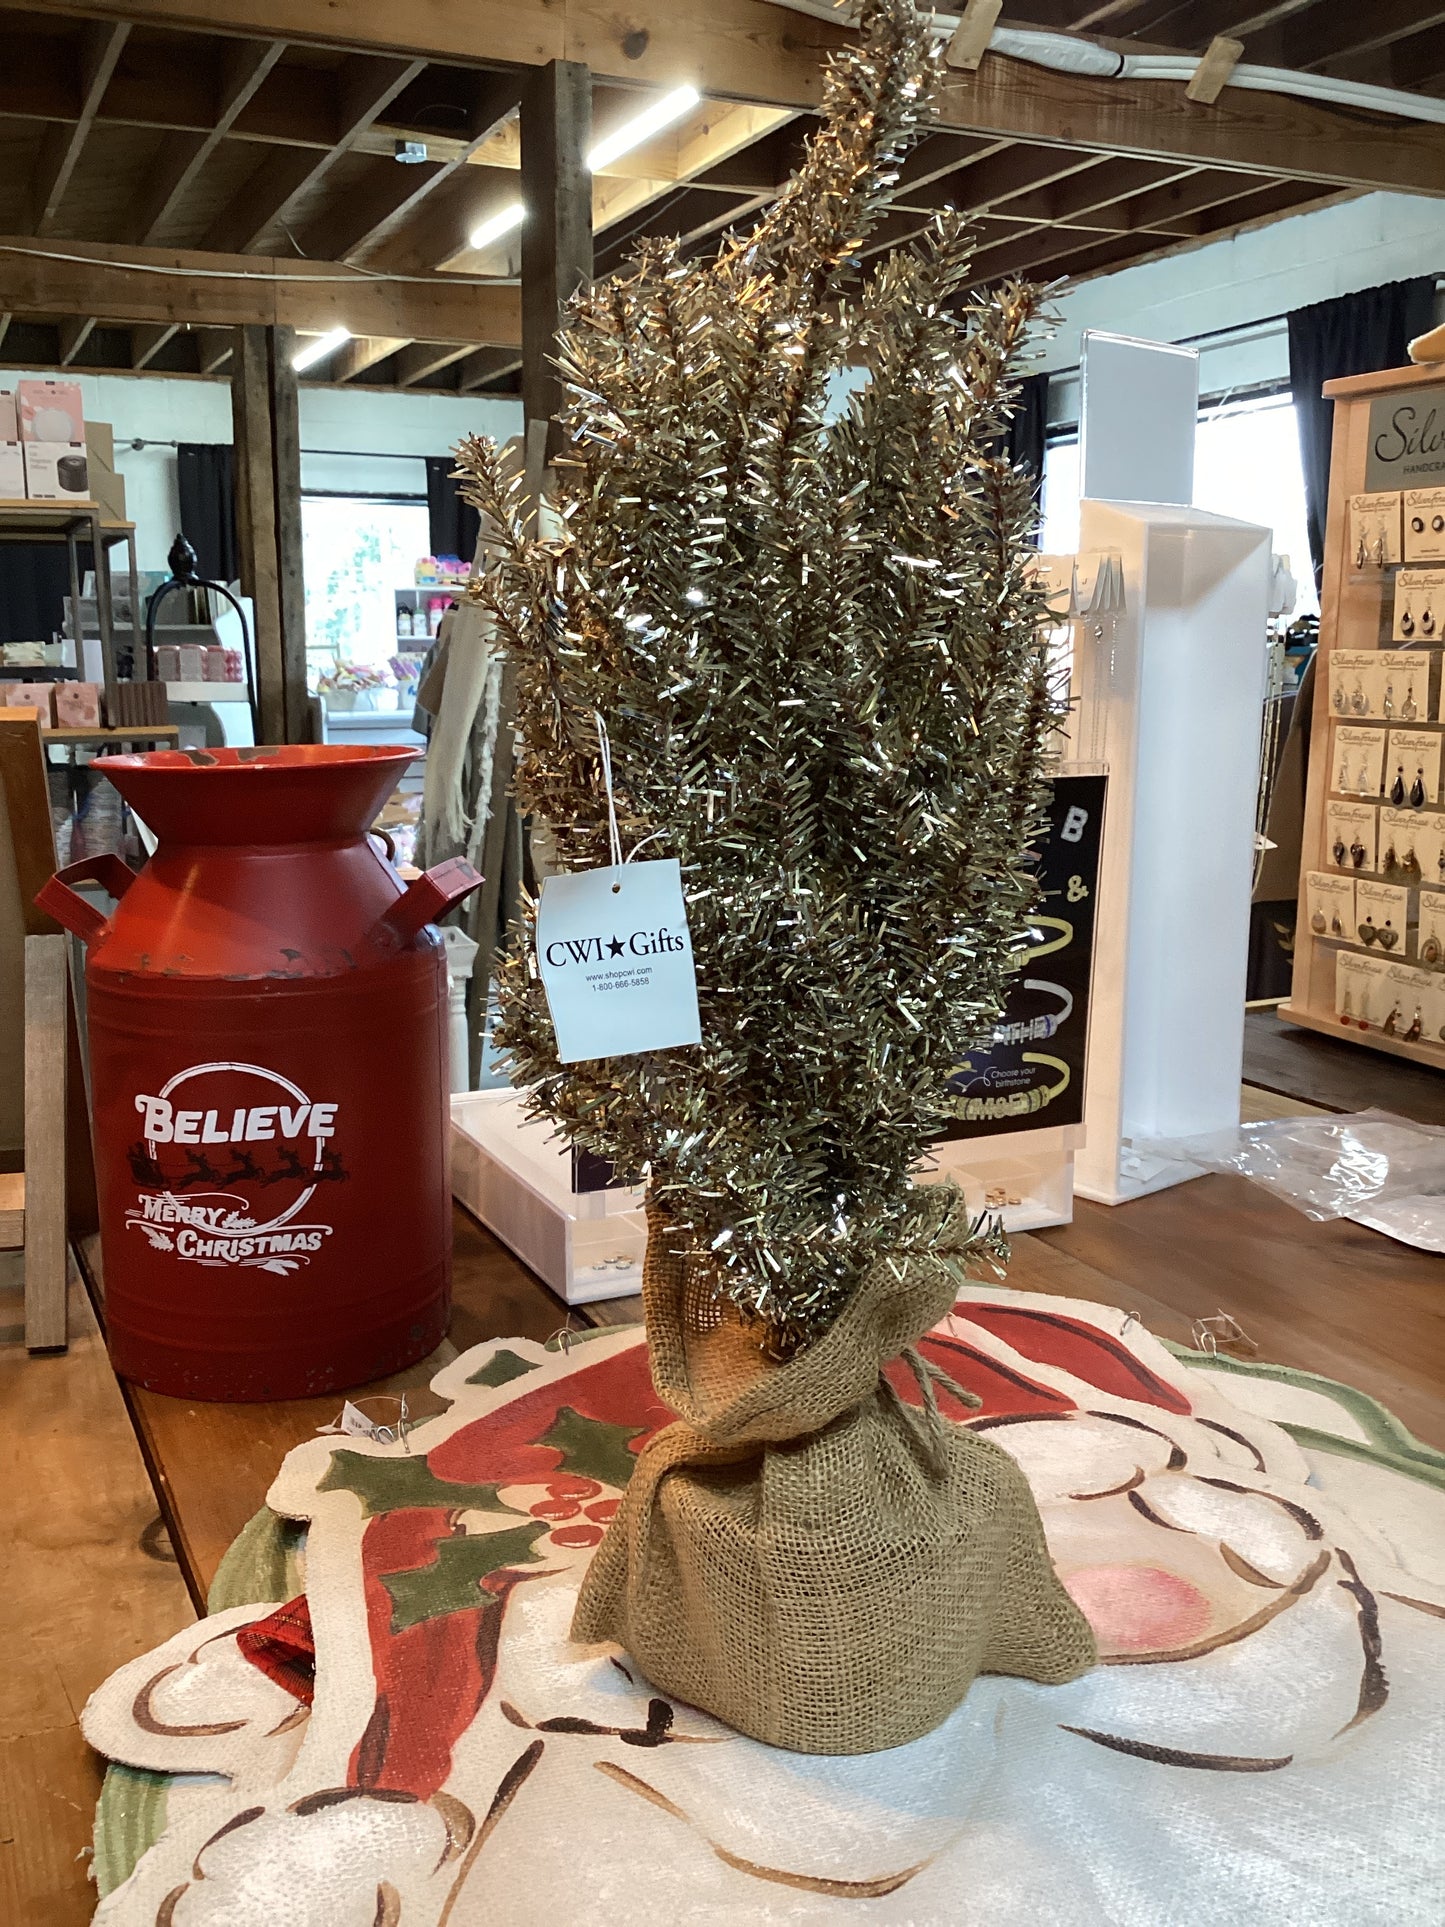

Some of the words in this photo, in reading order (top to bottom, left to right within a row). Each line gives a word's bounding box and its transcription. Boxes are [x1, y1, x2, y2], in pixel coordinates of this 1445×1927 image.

[1061, 805, 1089, 843] B
[546, 936, 605, 967] CWI
[629, 927, 685, 956] Gifts
[586, 966, 653, 982] www.shopcwi.com
[592, 976, 650, 992] 1-800-666-5858
[991, 1069, 1019, 1079] Choose
[135, 1094, 339, 1144] BELIEVE
[138, 1194, 227, 1227] MERRY
[177, 1230, 322, 1262] CHRISTMAS
